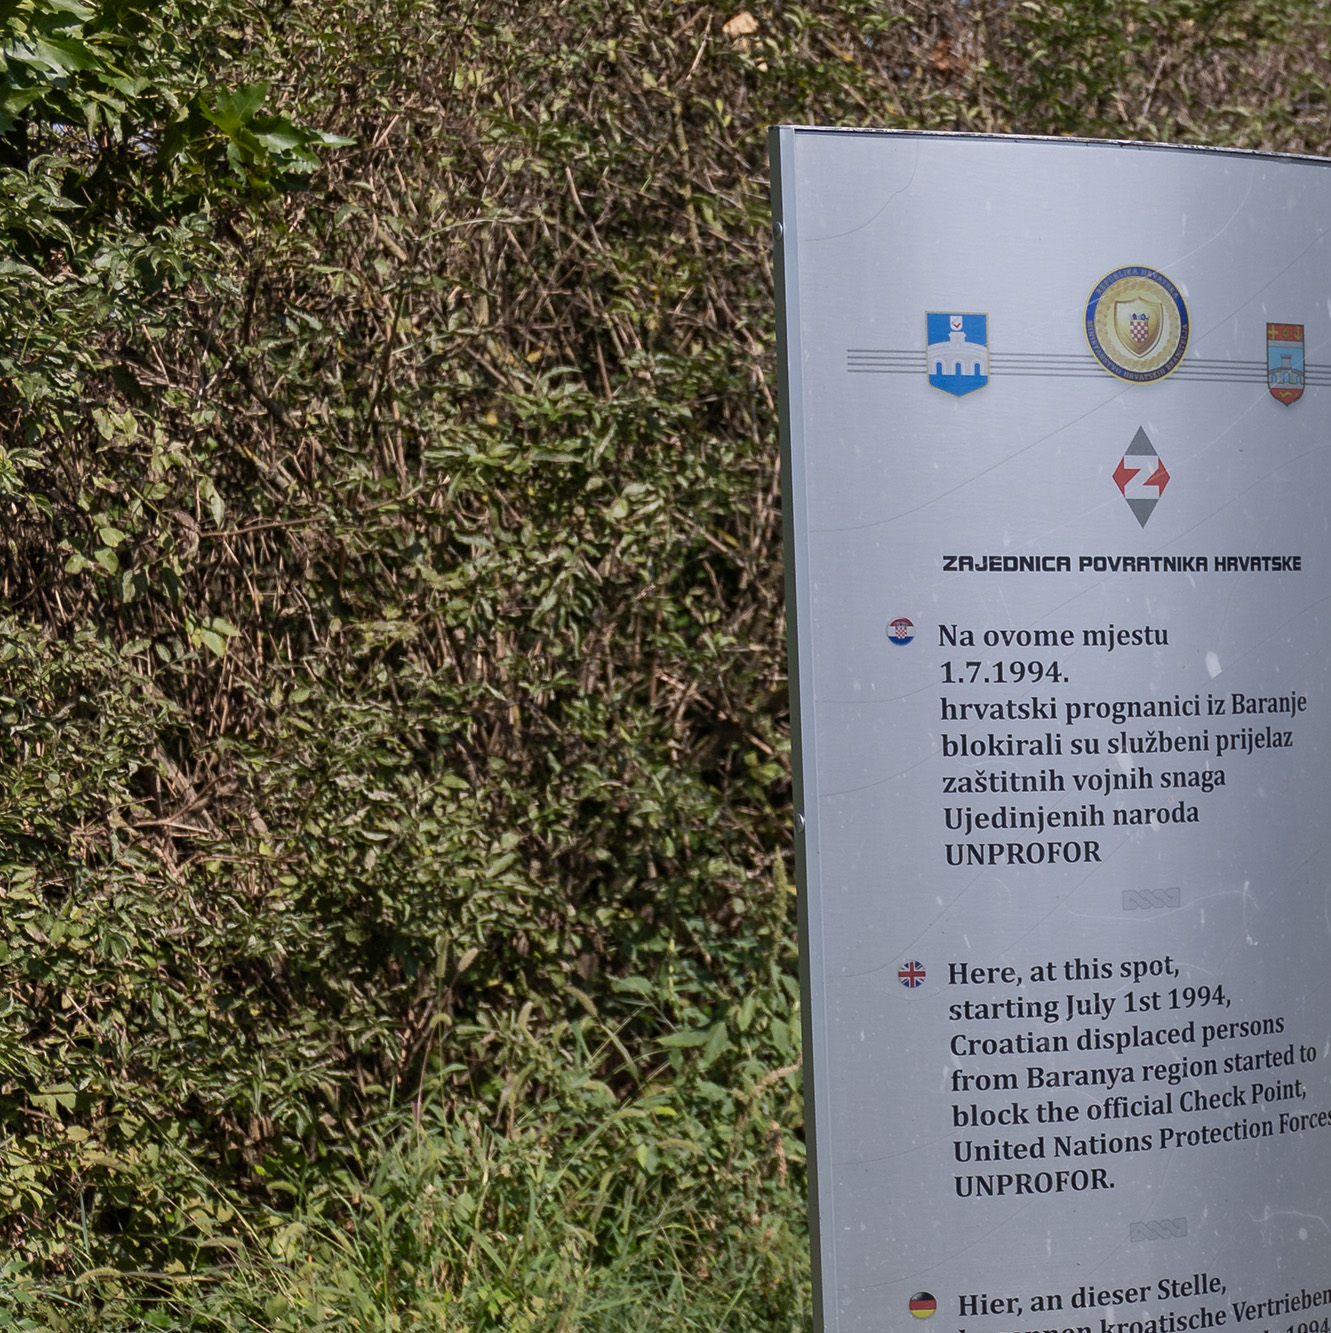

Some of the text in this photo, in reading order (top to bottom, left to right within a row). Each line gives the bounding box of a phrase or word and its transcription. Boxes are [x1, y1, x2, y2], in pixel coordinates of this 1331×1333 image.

[1096, 268, 1179, 298] REPUBLIKA HRVATSKA
[1123, 368, 1166, 381] HRVATSKIH
[1167, 323, 1188, 370] BRANITELJA
[942, 555, 1302, 573] ZAJEDNICA POVRATNIKA HRVATSKE
[937, 623, 1169, 653] Na ovome mjestu
[940, 660, 1069, 684] 1.7.1994.
[939, 690, 1307, 726] hrvatski prognanici iz Baranje
[940, 726, 1293, 758] blokirali su službeni prijelaz
[942, 766, 1227, 797] zaštitnih vojnih snaga
[943, 800, 1200, 836] Ujedinjenih naroda
[944, 840, 1103, 866] UNPROFOR
[947, 955, 1180, 987] Here, at this spot,
[948, 984, 1231, 1024] starting July 1st 1994,
[950, 1016, 1285, 1056] Croatian displaced persons
[950, 1043, 1317, 1092] from Baranya region started to
[951, 1079, 1307, 1128] block the official Check Point,
[952, 1136, 1046, 1163] United
[1053, 1132, 1153, 1158] Nations
[1159, 1118, 1274, 1150] Protection
[953, 1168, 1115, 1198] UNPROFOR.
[958, 1272, 1227, 1317] Hier, an dieser Stelle,
